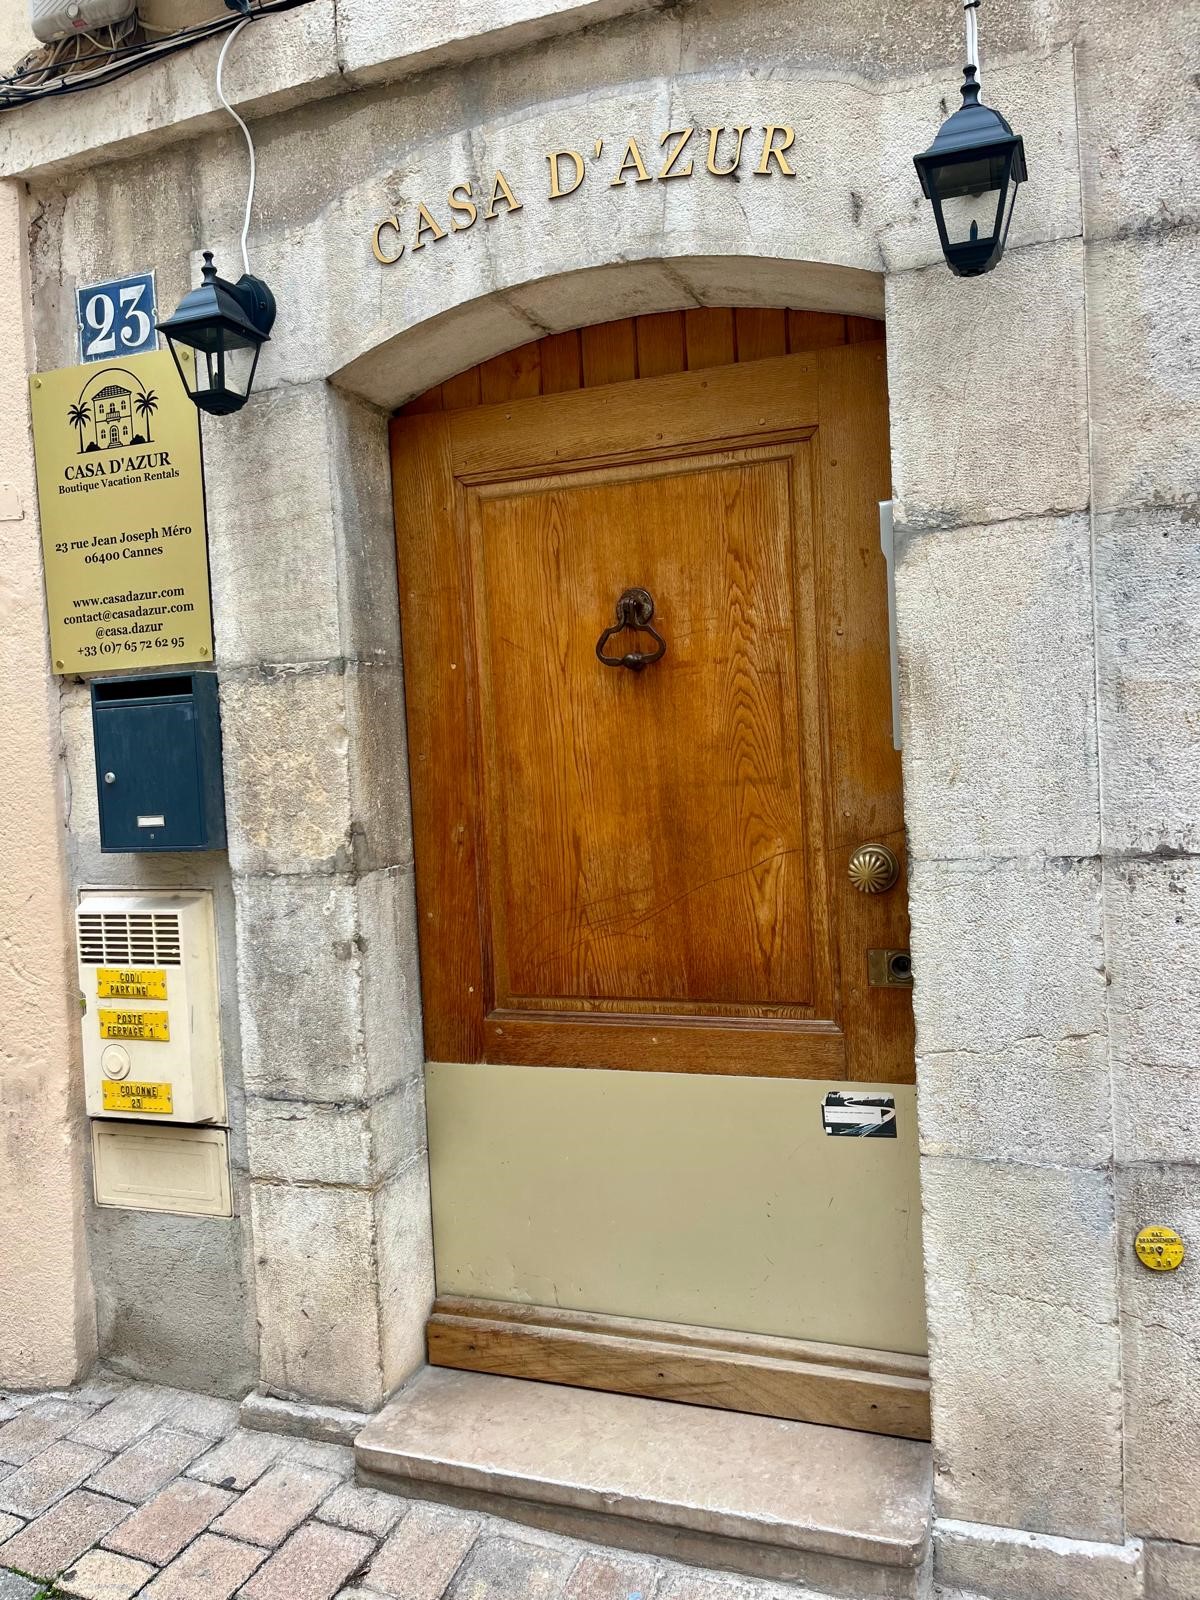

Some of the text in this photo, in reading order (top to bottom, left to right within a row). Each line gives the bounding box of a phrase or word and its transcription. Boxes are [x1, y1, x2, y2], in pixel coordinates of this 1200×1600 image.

[370, 123, 798, 266] CASA D'AZUR
[85, 284, 151, 356] 23
[64, 451, 172, 481] CASA D'AZUR
[58, 468, 180, 495] Boutique Vacation Rentals
[55, 524, 192, 553] 23 rue Jean Joseph Méro
[84, 545, 164, 565] 06400 Cannes
[72, 586, 185, 608] www.casadazur.com
[63, 601, 195, 625] contact@casadazur.com
[95, 621, 164, 640] @casa.dazur
[77, 636, 185, 657] +33 (0)7 65 72 62 95
[110, 984, 147, 995] PARKING
[116, 1014, 143, 1024] POSTE
[120, 1085, 158, 1096] COLONNE
